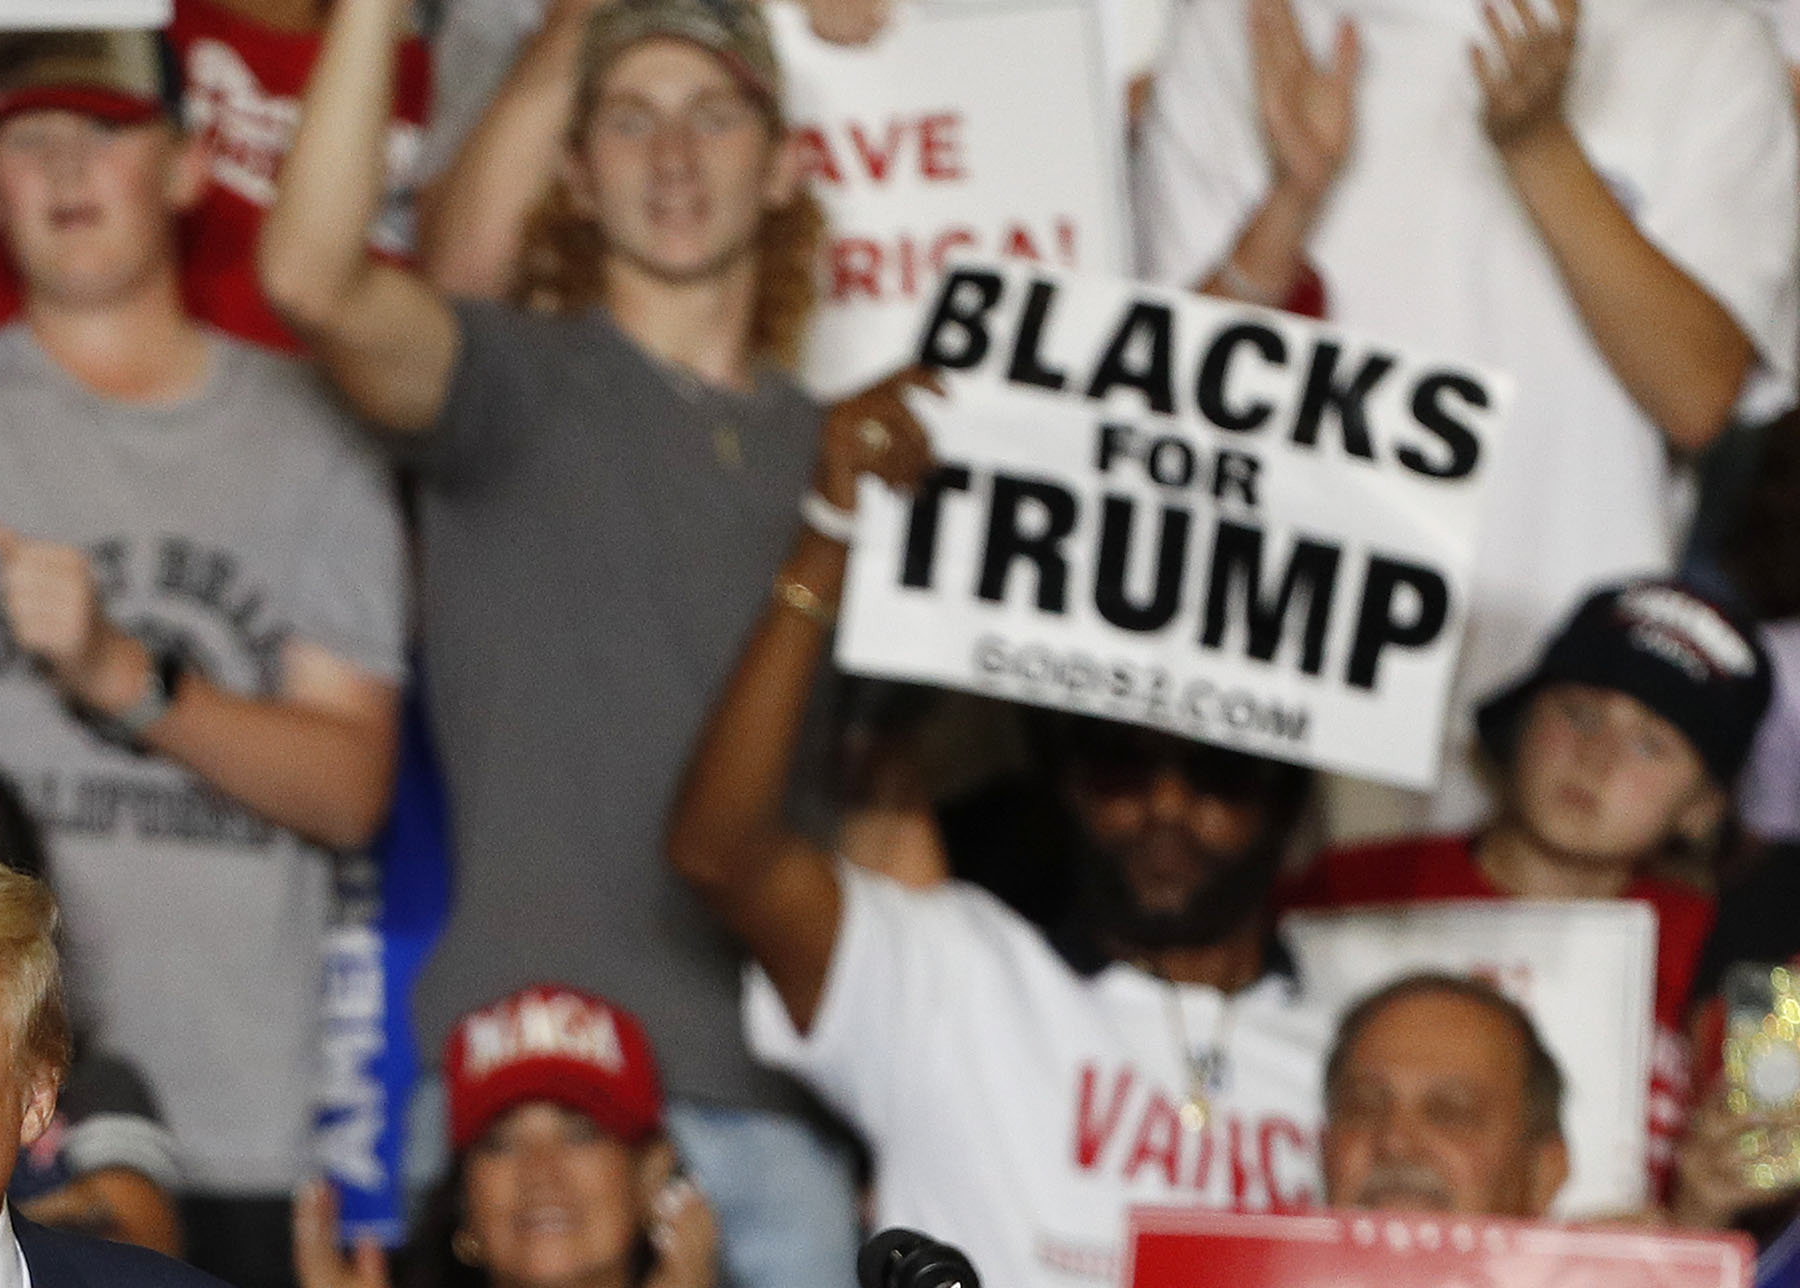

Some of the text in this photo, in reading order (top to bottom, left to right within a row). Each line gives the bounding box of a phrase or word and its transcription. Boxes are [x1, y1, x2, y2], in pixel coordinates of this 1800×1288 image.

[800, 113, 970, 186] AVE
[920, 268, 1492, 480] BLACKS
[1097, 422, 1264, 506] FOR
[897, 462, 1449, 692] TRUMP
